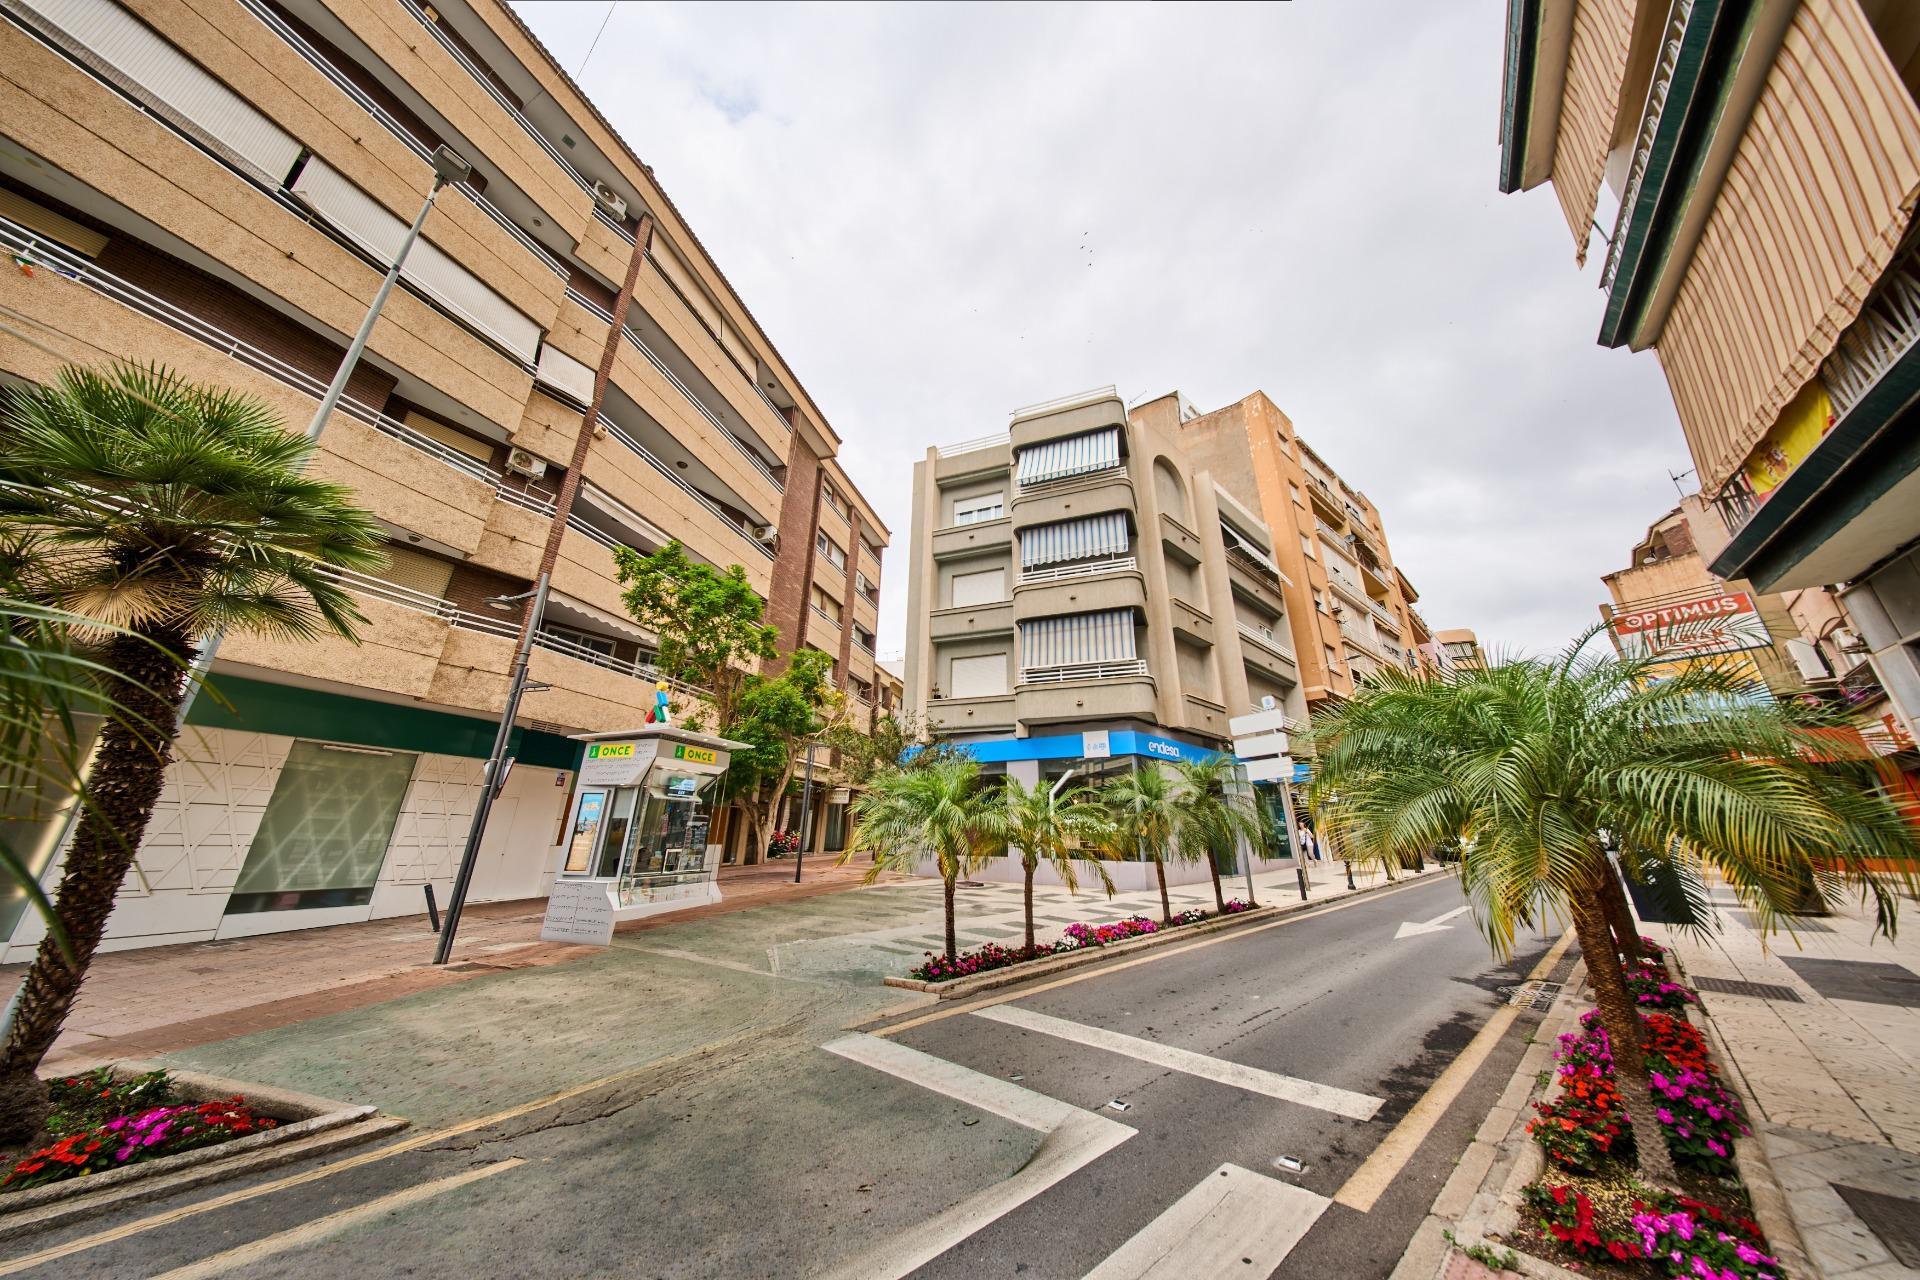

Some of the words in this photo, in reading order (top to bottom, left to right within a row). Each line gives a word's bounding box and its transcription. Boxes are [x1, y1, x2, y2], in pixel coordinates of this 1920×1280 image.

[1625, 597, 1739, 628] OPTIMUS
[602, 745, 631, 756] ONCE
[687, 749, 713, 762] ONCE
[1148, 741, 1180, 757] endesa
